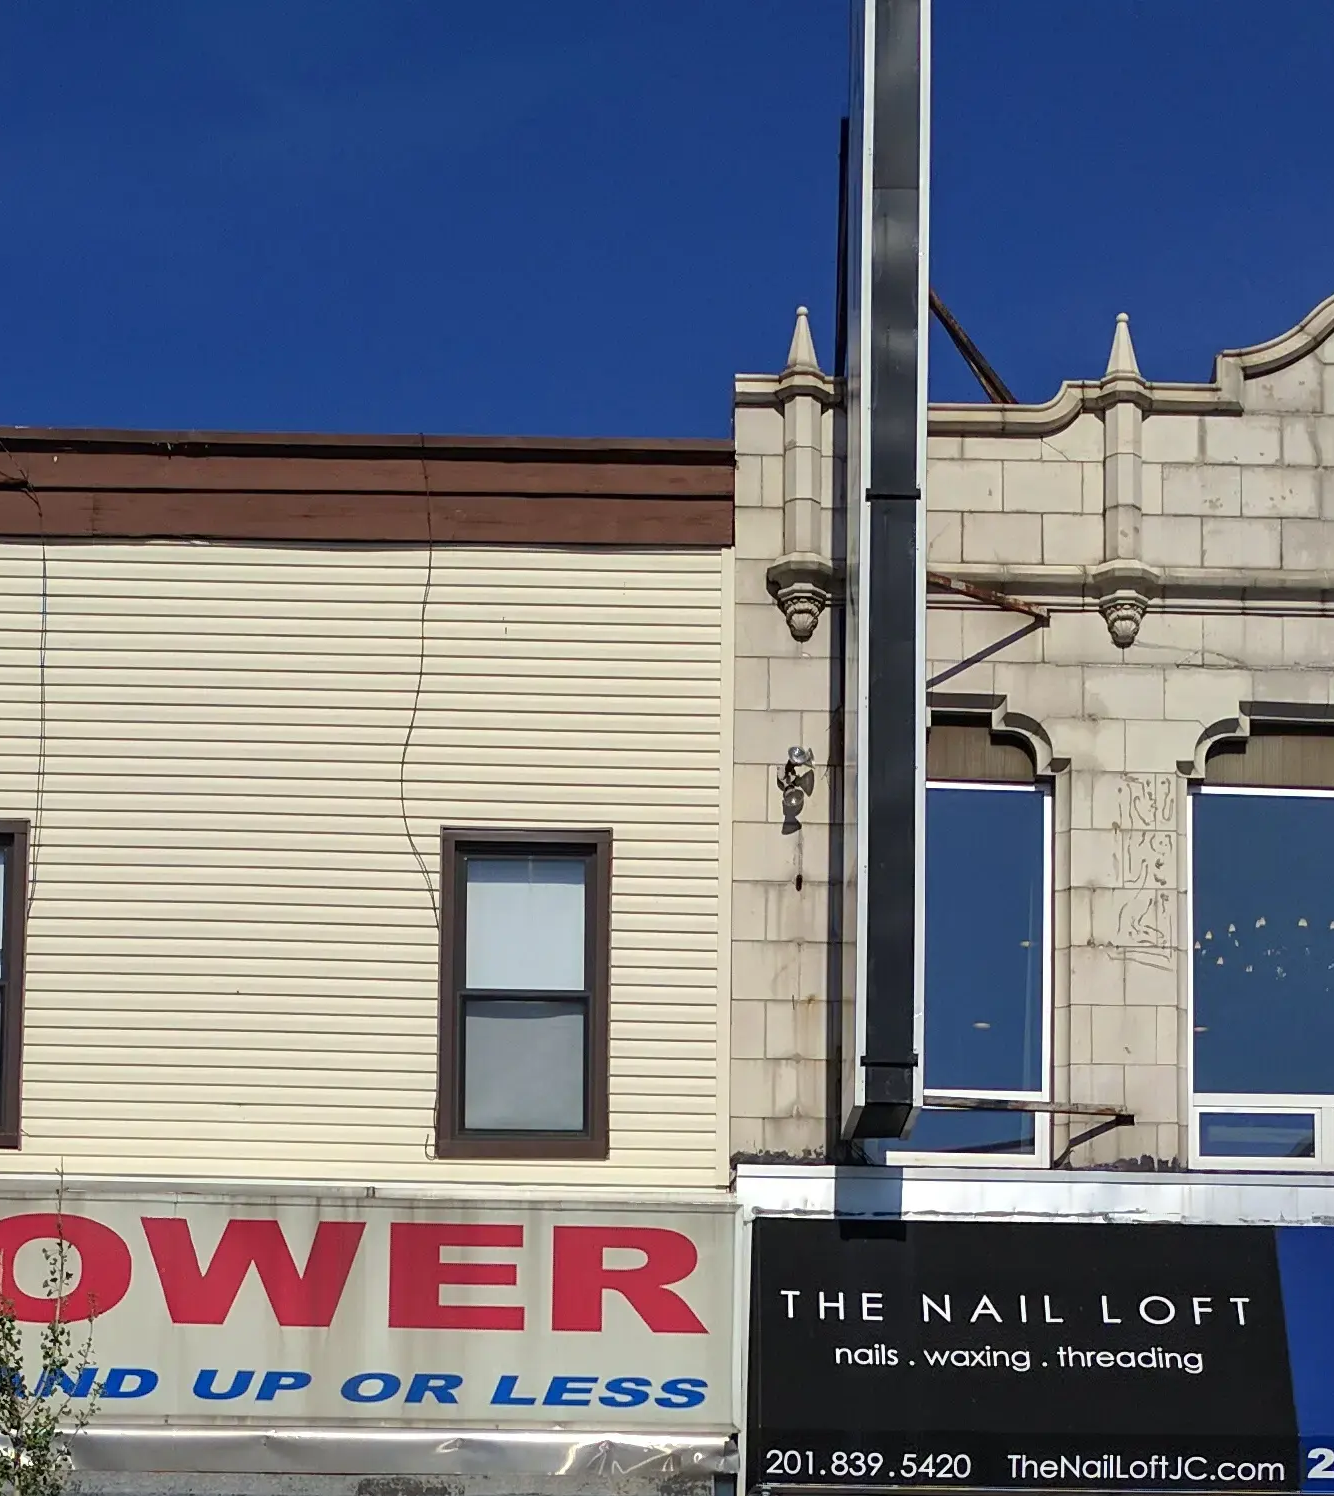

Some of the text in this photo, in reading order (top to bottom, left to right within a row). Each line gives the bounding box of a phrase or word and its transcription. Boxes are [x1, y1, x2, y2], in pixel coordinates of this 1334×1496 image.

[780, 1289, 1250, 1327] THE NAIL LOFT
[834, 1343, 899, 1367] nails
[923, 1345, 1031, 1373] waxing
[1056, 1346, 1204, 1375] threading
[193, 1369, 313, 1402] UP
[340, 1371, 466, 1405] OR
[489, 1374, 709, 1409] LESS
[766, 1448, 1285, 1482] 201.839.5420 TheNailLoftJC.com
